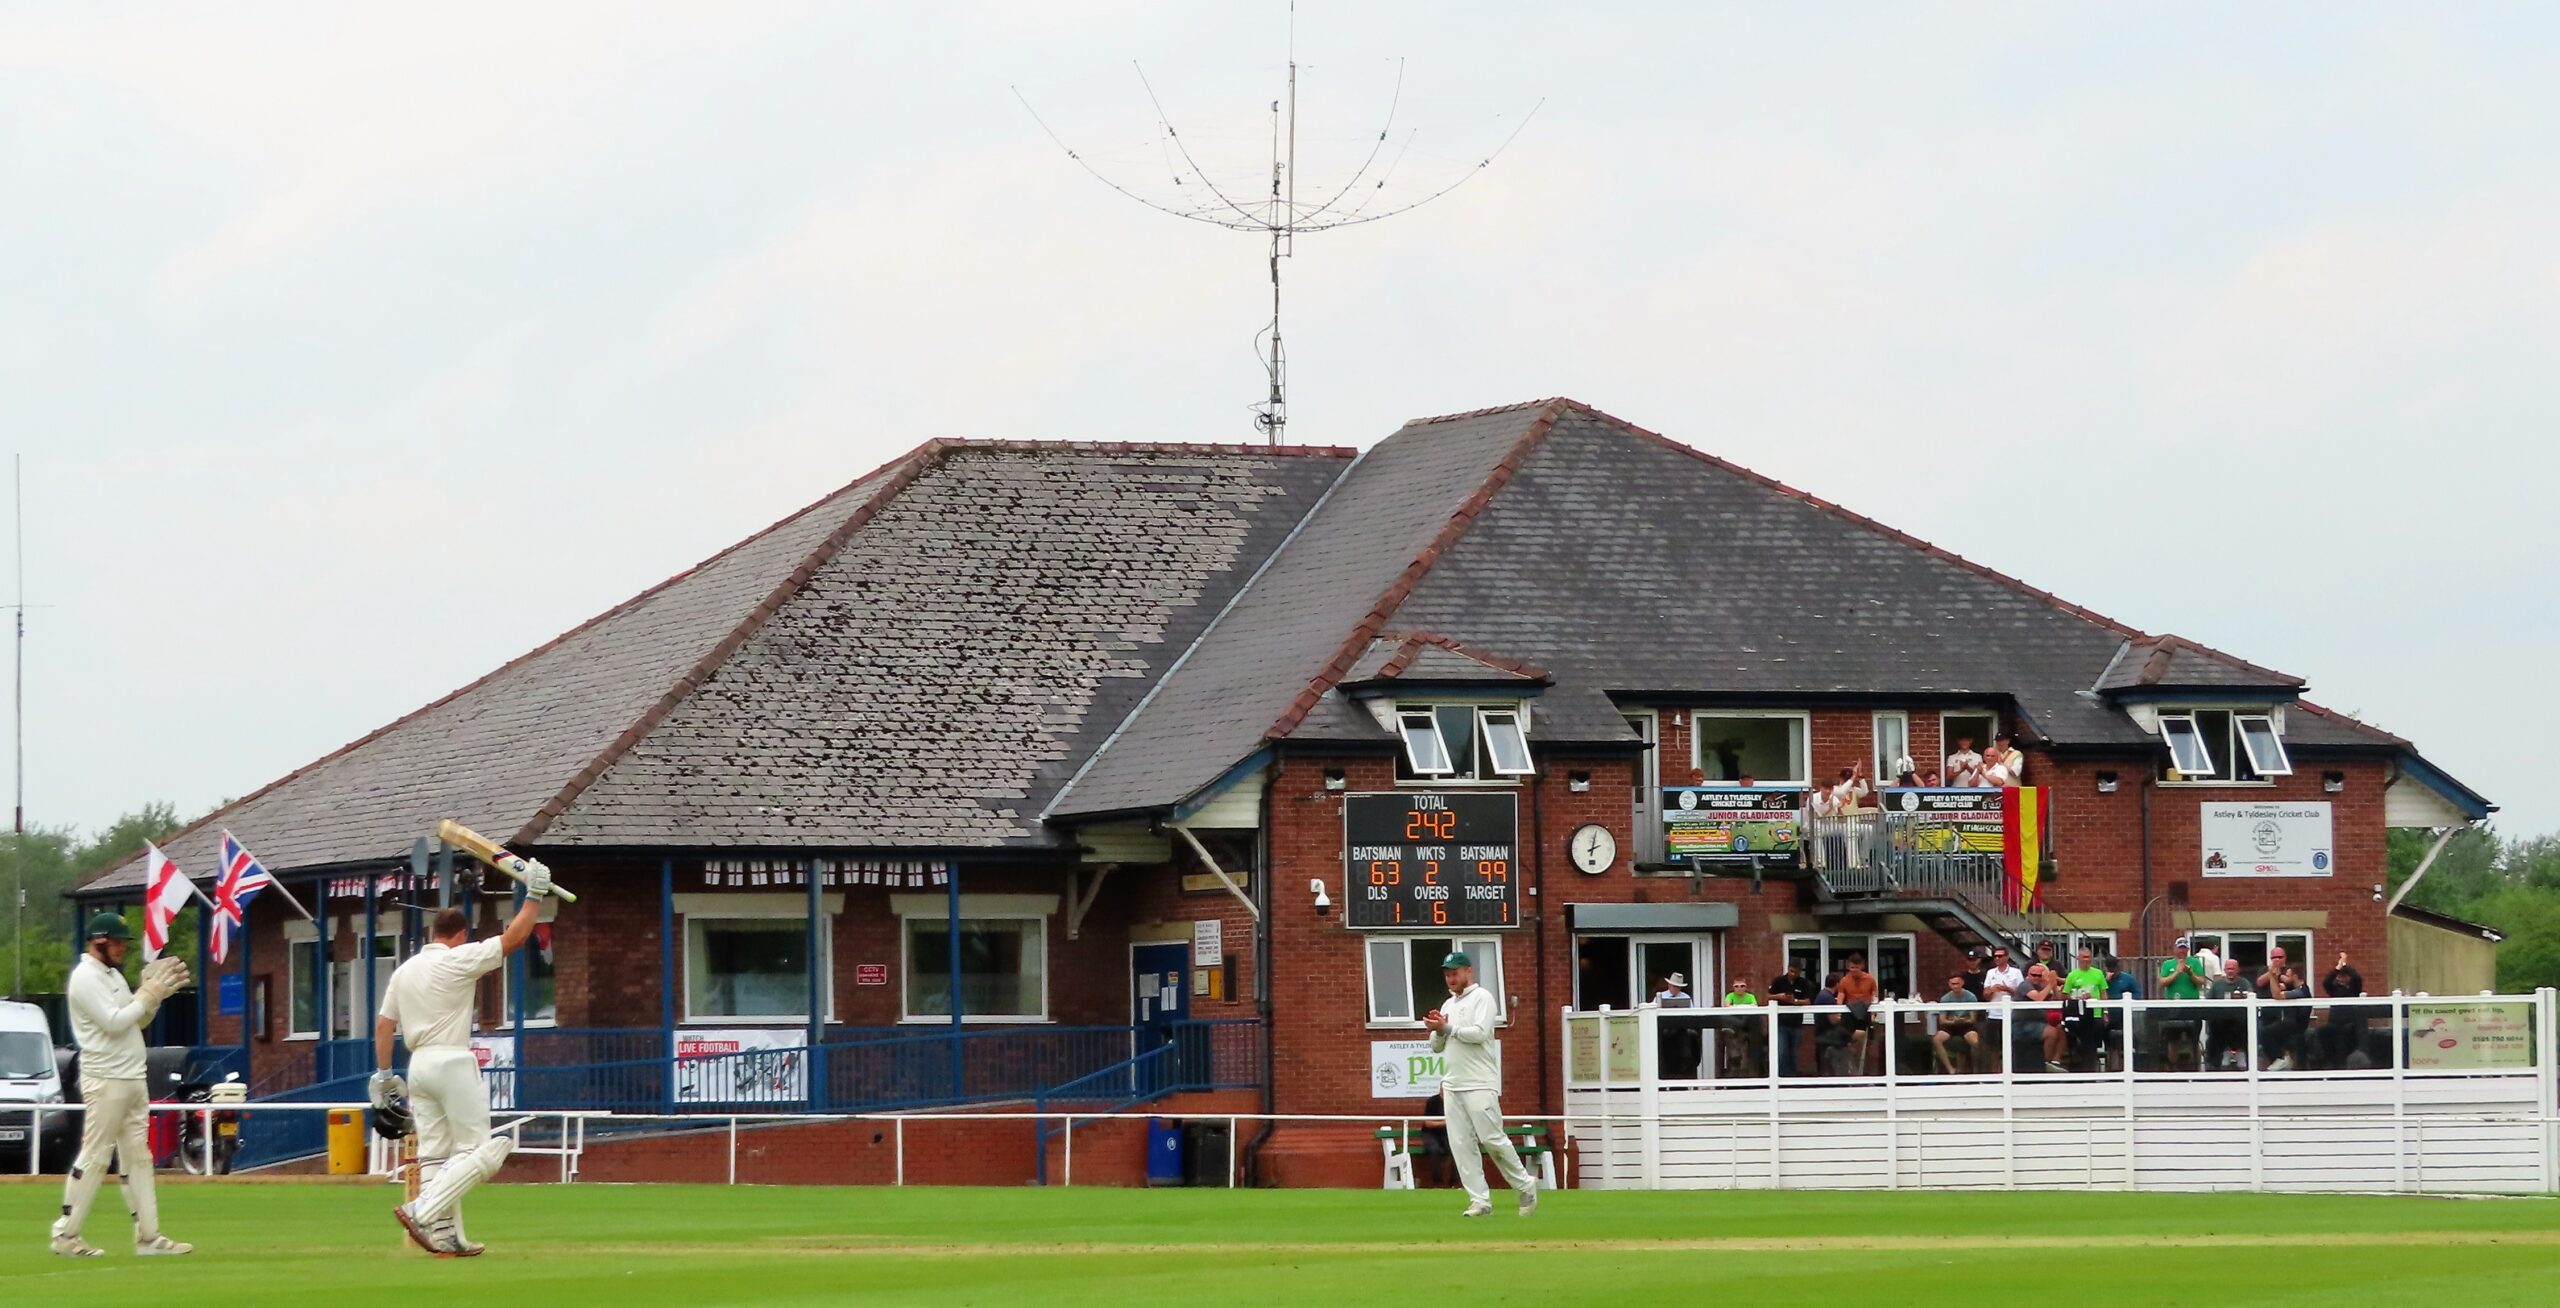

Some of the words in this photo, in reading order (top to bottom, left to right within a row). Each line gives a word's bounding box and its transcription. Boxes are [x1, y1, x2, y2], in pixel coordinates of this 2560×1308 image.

[1413, 795, 1448, 810] TOTAL
[1711, 800, 1736, 808] CRICKET
[1736, 800, 1753, 808] CLUB
[1707, 811, 1738, 820] JUNIOR
[1740, 811, 1793, 820] GLADIATORS!
[1929, 812, 1959, 821] JUNIOR
[2213, 810, 2235, 819] Astley
[2237, 810, 2243, 818] &
[2244, 810, 2277, 819] Tyldesley
[2279, 810, 2303, 818] Cricket
[2304, 810, 2320, 818] Club
[1406, 811, 1456, 839] 242
[1353, 846, 1402, 861] BATSMAN
[1416, 846, 1446, 860] WKTS
[1460, 846, 1508, 860] BATSMAN
[1371, 861, 1400, 885] 63
[1425, 861, 1439, 885] 2
[1478, 861, 1507, 883] 99
[1367, 886, 1388, 901] DLS
[1414, 885, 1449, 900] OVERS
[1465, 885, 1506, 900] TARGET
[1394, 902, 1401, 924] 1
[1433, 900, 1447, 925] 6
[1502, 901, 1509, 923] 1
[679, 1043, 698, 1053] LIVE
[699, 1042, 738, 1053] FOOTBALL
